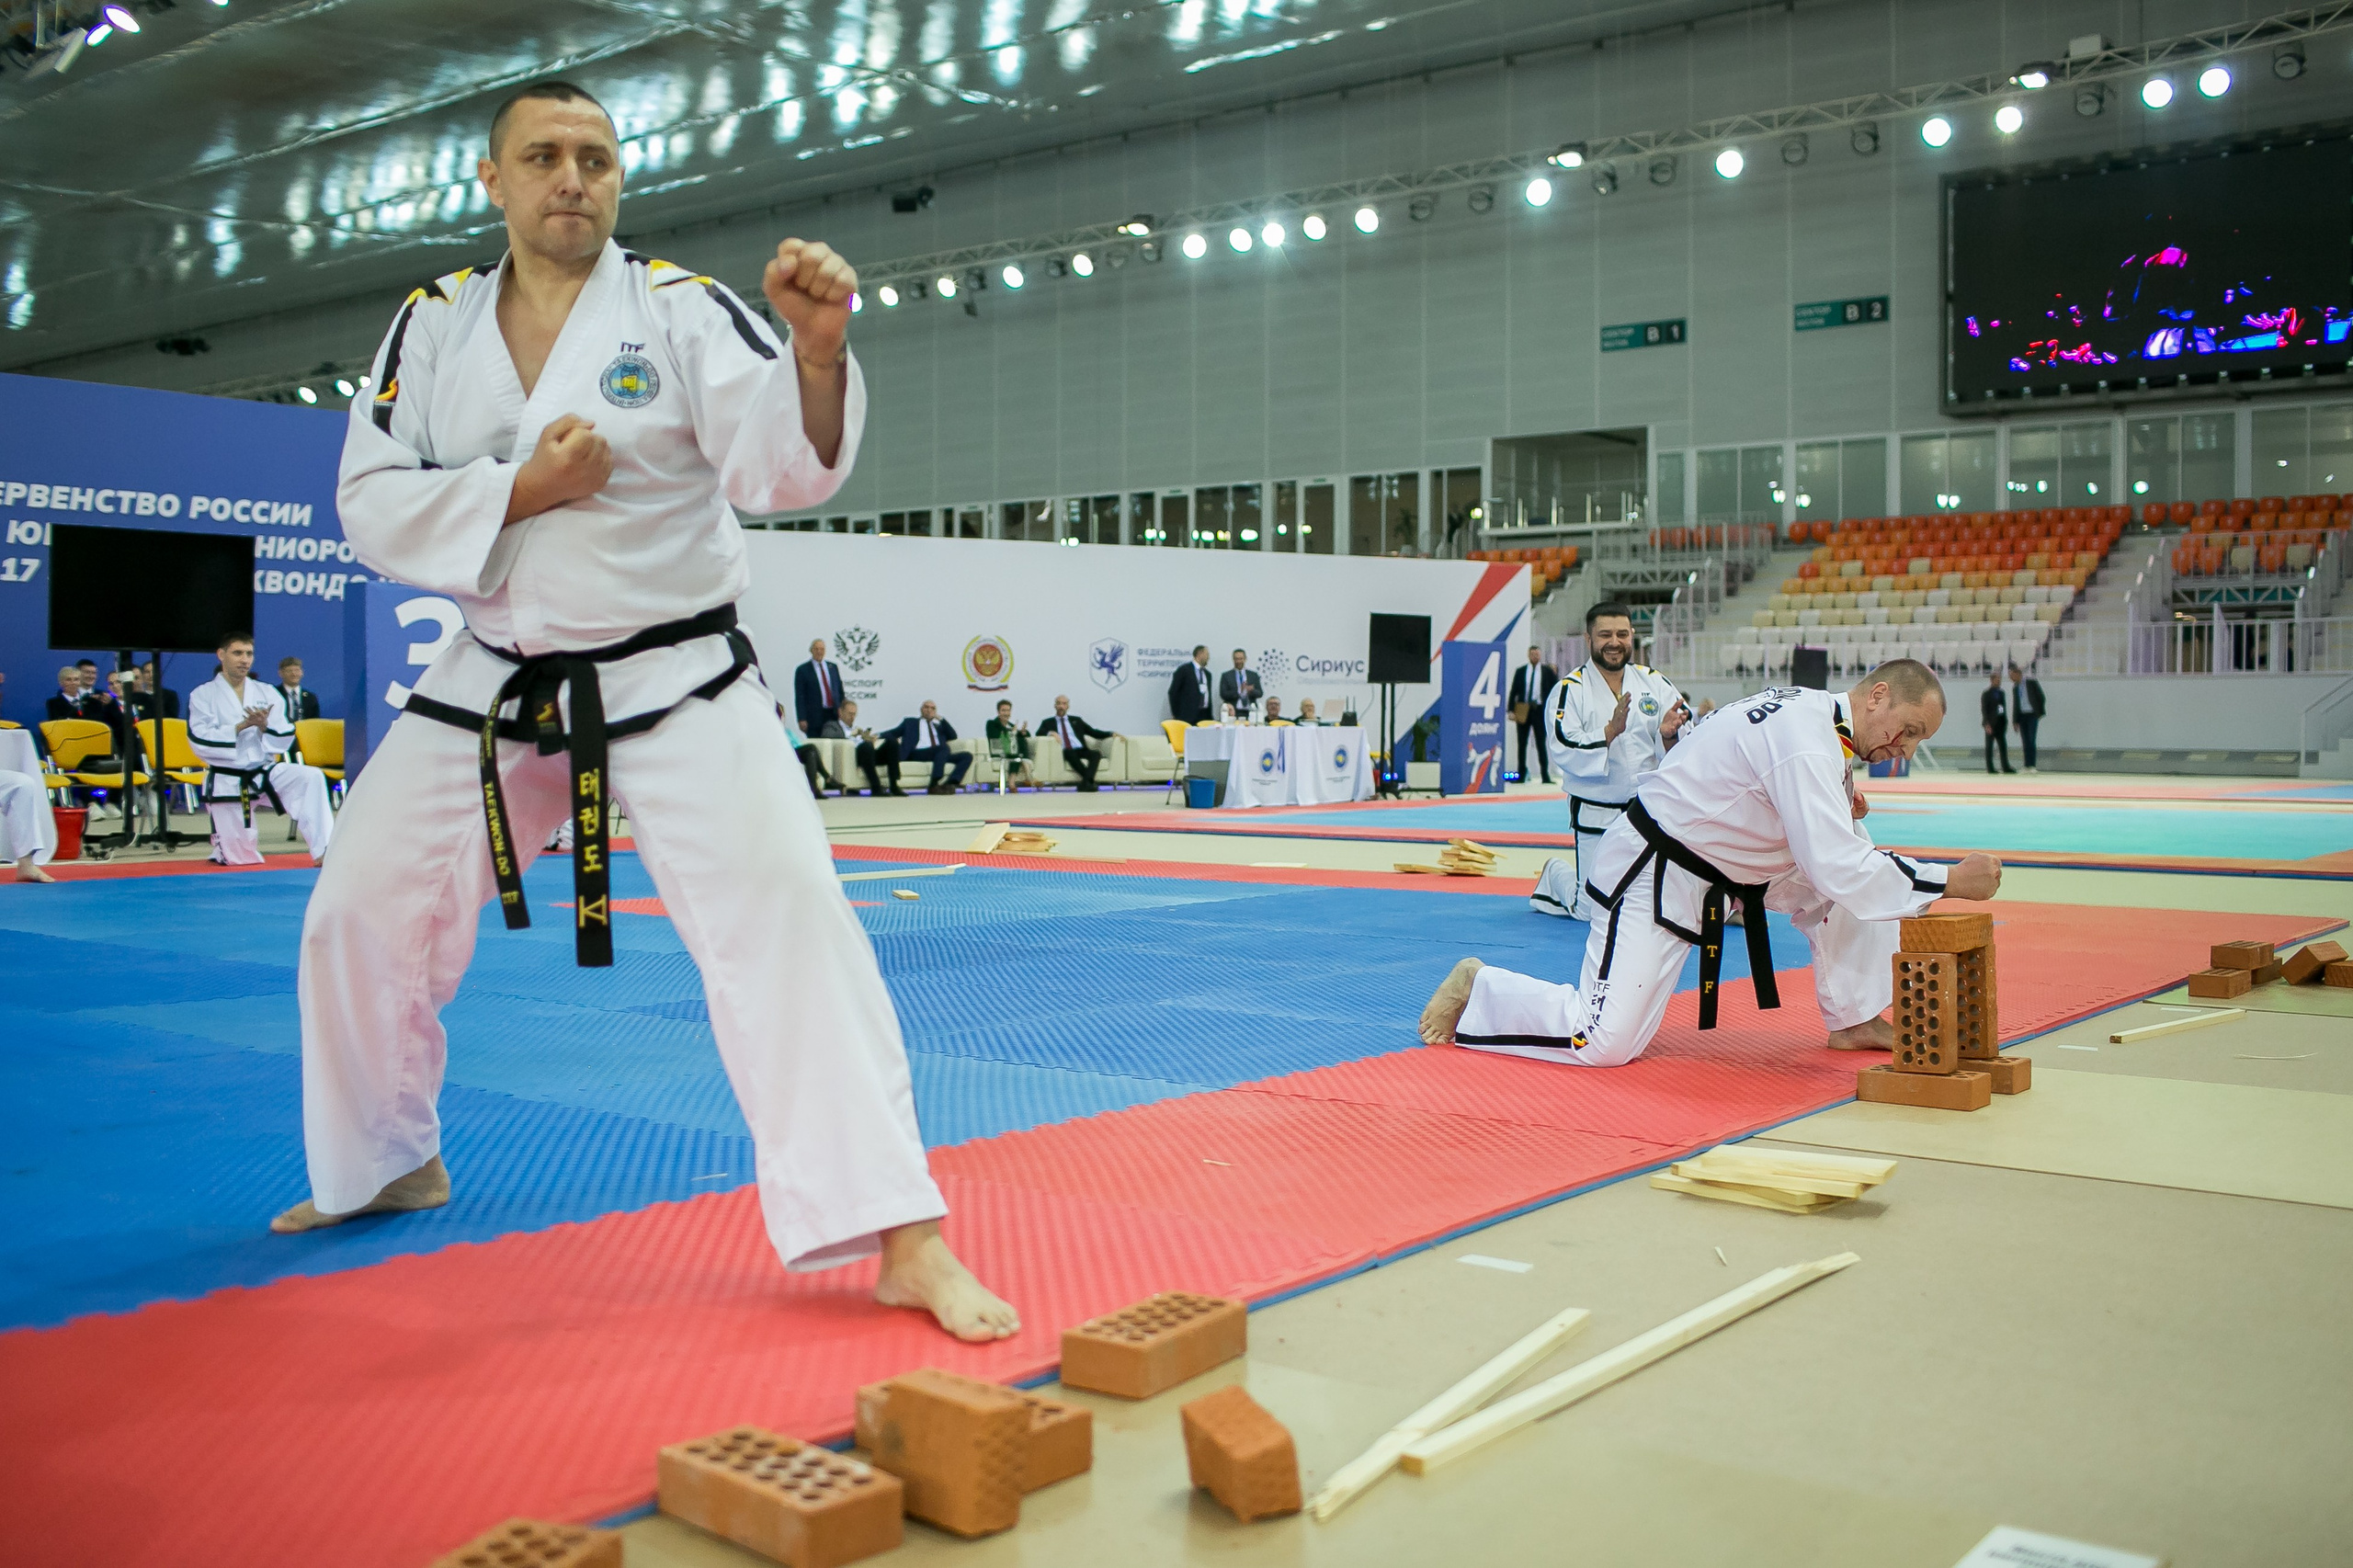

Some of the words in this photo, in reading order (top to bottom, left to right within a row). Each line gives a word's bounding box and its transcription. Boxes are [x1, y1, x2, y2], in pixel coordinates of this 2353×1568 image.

[620, 342, 645, 353] ITF
[0, 481, 180, 517] РВЕНСТВО
[188, 495, 313, 528] РОССИИ
[256, 535, 362, 564] НИОРО
[0, 557, 41, 583] 17
[1296, 654, 1365, 676] Сириус
[1469, 651, 1501, 720] 4
[484, 781, 511, 876] TAEKWON-DO
[1593, 981, 1611, 993] ITF
